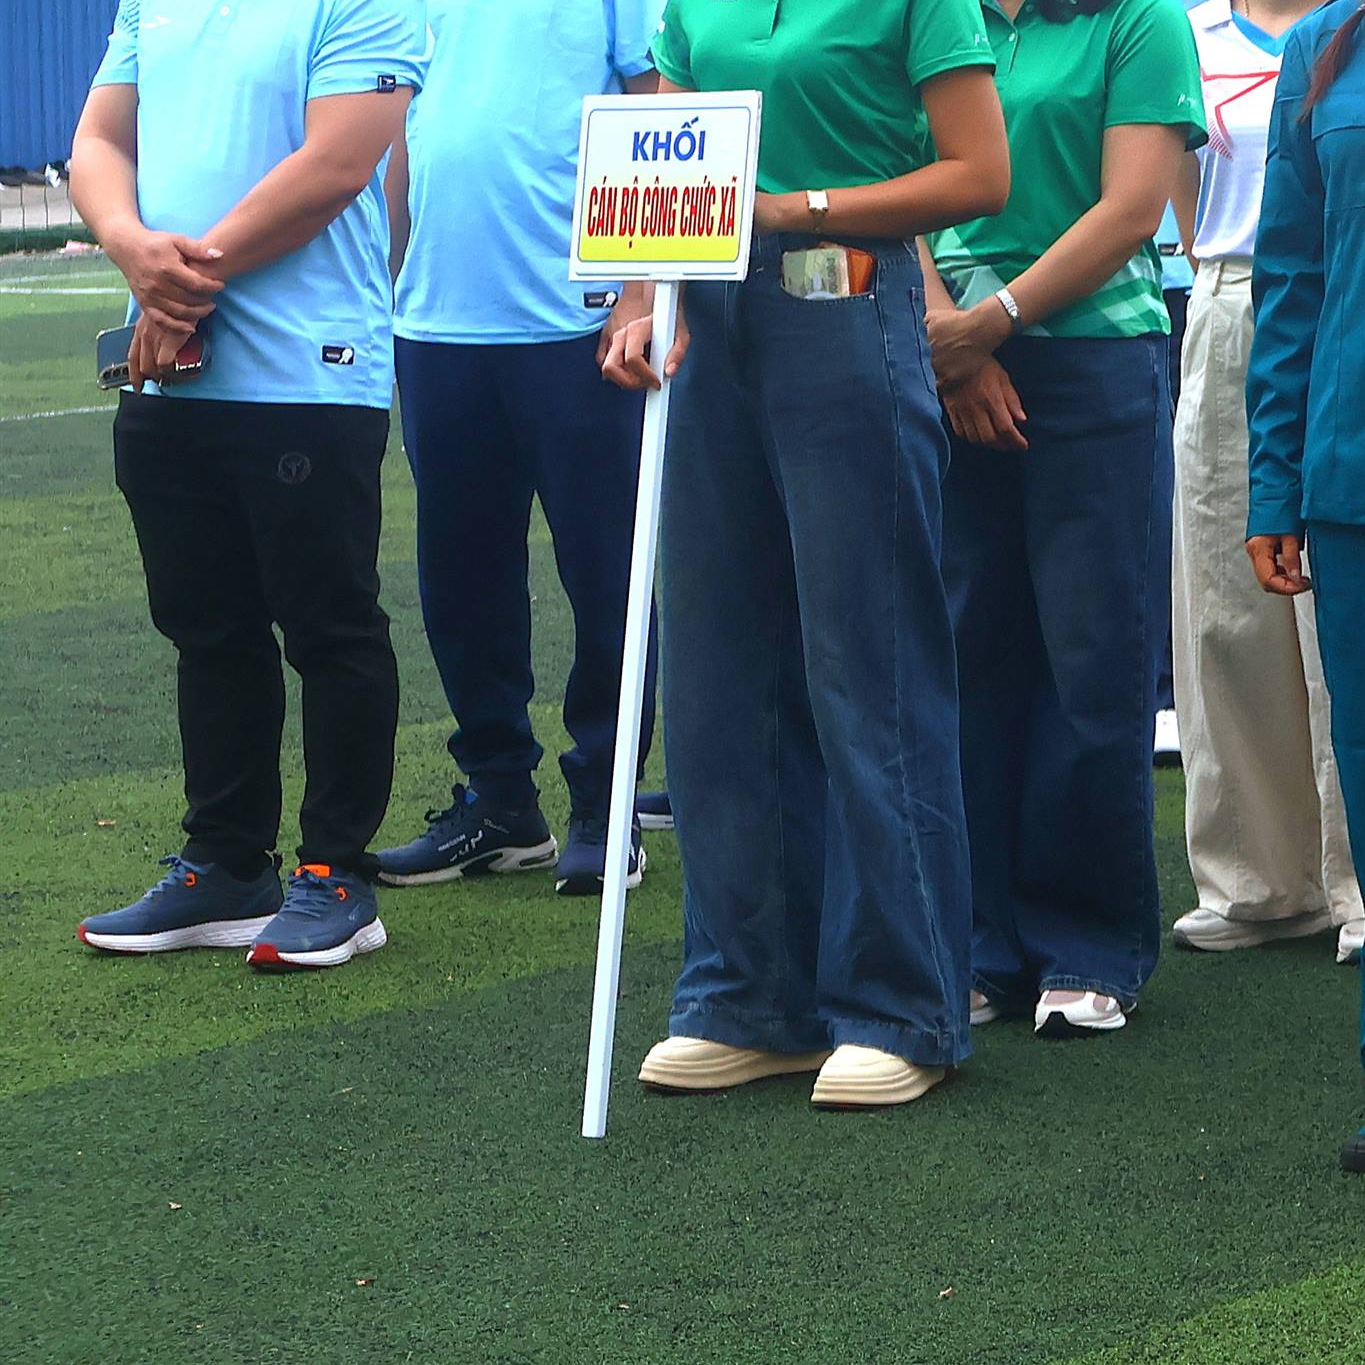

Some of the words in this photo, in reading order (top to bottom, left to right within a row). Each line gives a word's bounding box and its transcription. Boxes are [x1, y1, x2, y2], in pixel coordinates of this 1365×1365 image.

[632, 116, 706, 161] KHỐI
[587, 176, 617, 237] CÁN
[619, 176, 639, 248] BỘ
[641, 176, 678, 237] CÔNG
[680, 175, 716, 237] CHỨC
[717, 176, 738, 237] XÃ
